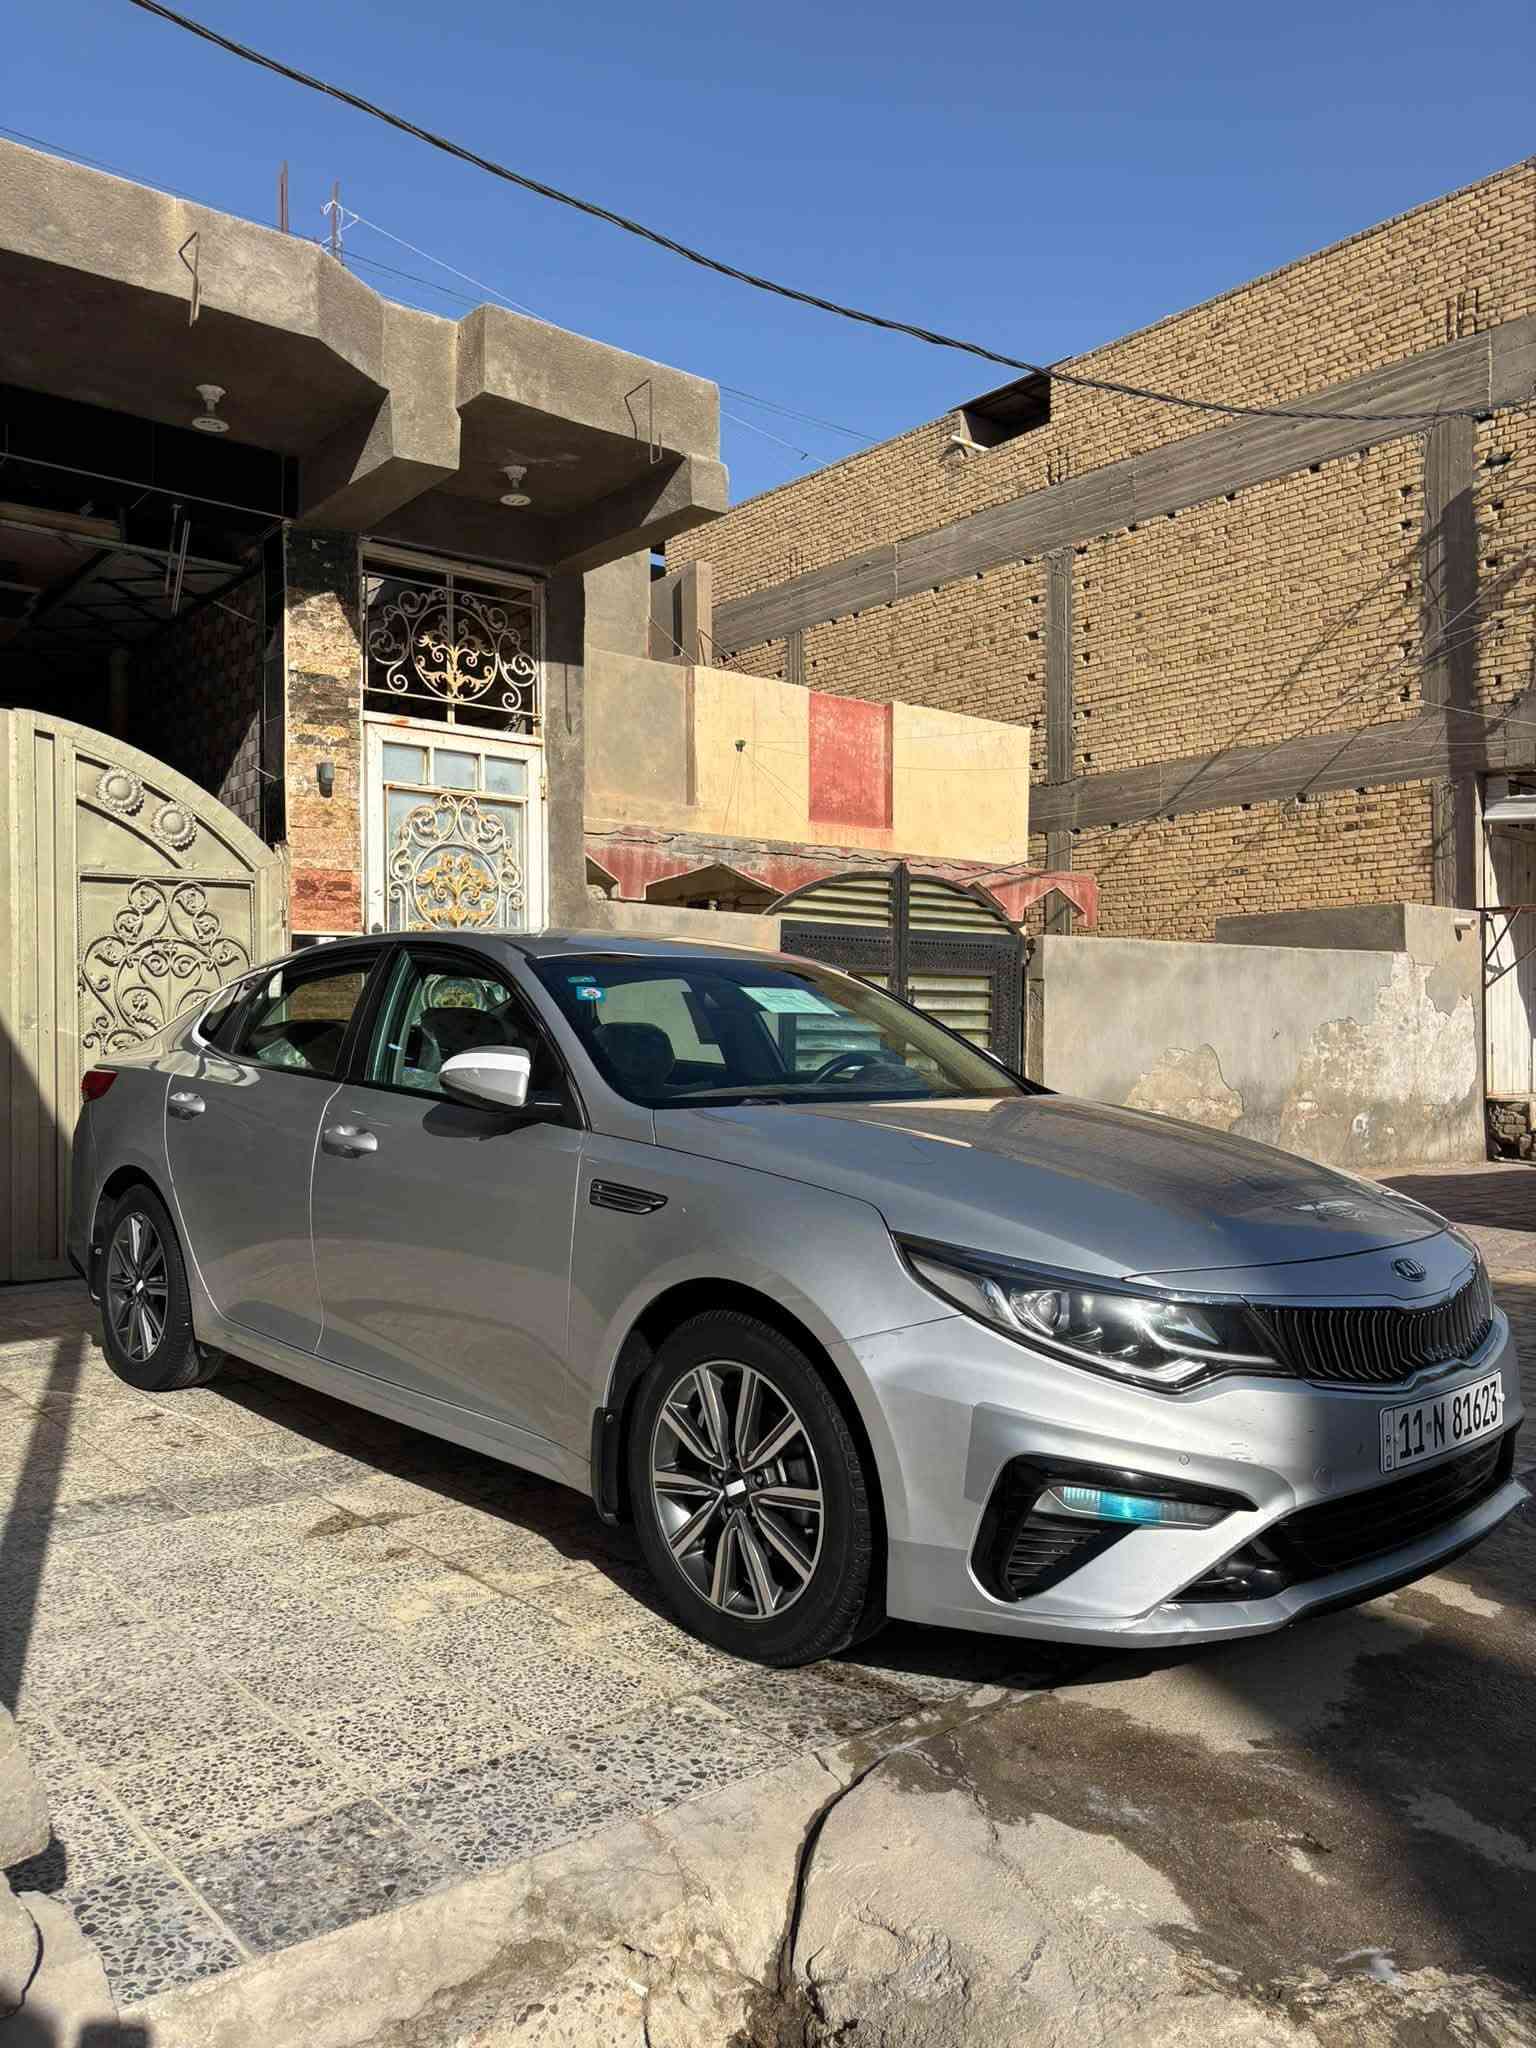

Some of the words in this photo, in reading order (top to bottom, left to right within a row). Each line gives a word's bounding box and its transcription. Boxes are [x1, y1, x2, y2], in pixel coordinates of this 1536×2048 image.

[1399, 1409, 1425, 1459] 11
[1432, 1402, 1445, 1448] N
[1452, 1380, 1498, 1440] 81623
